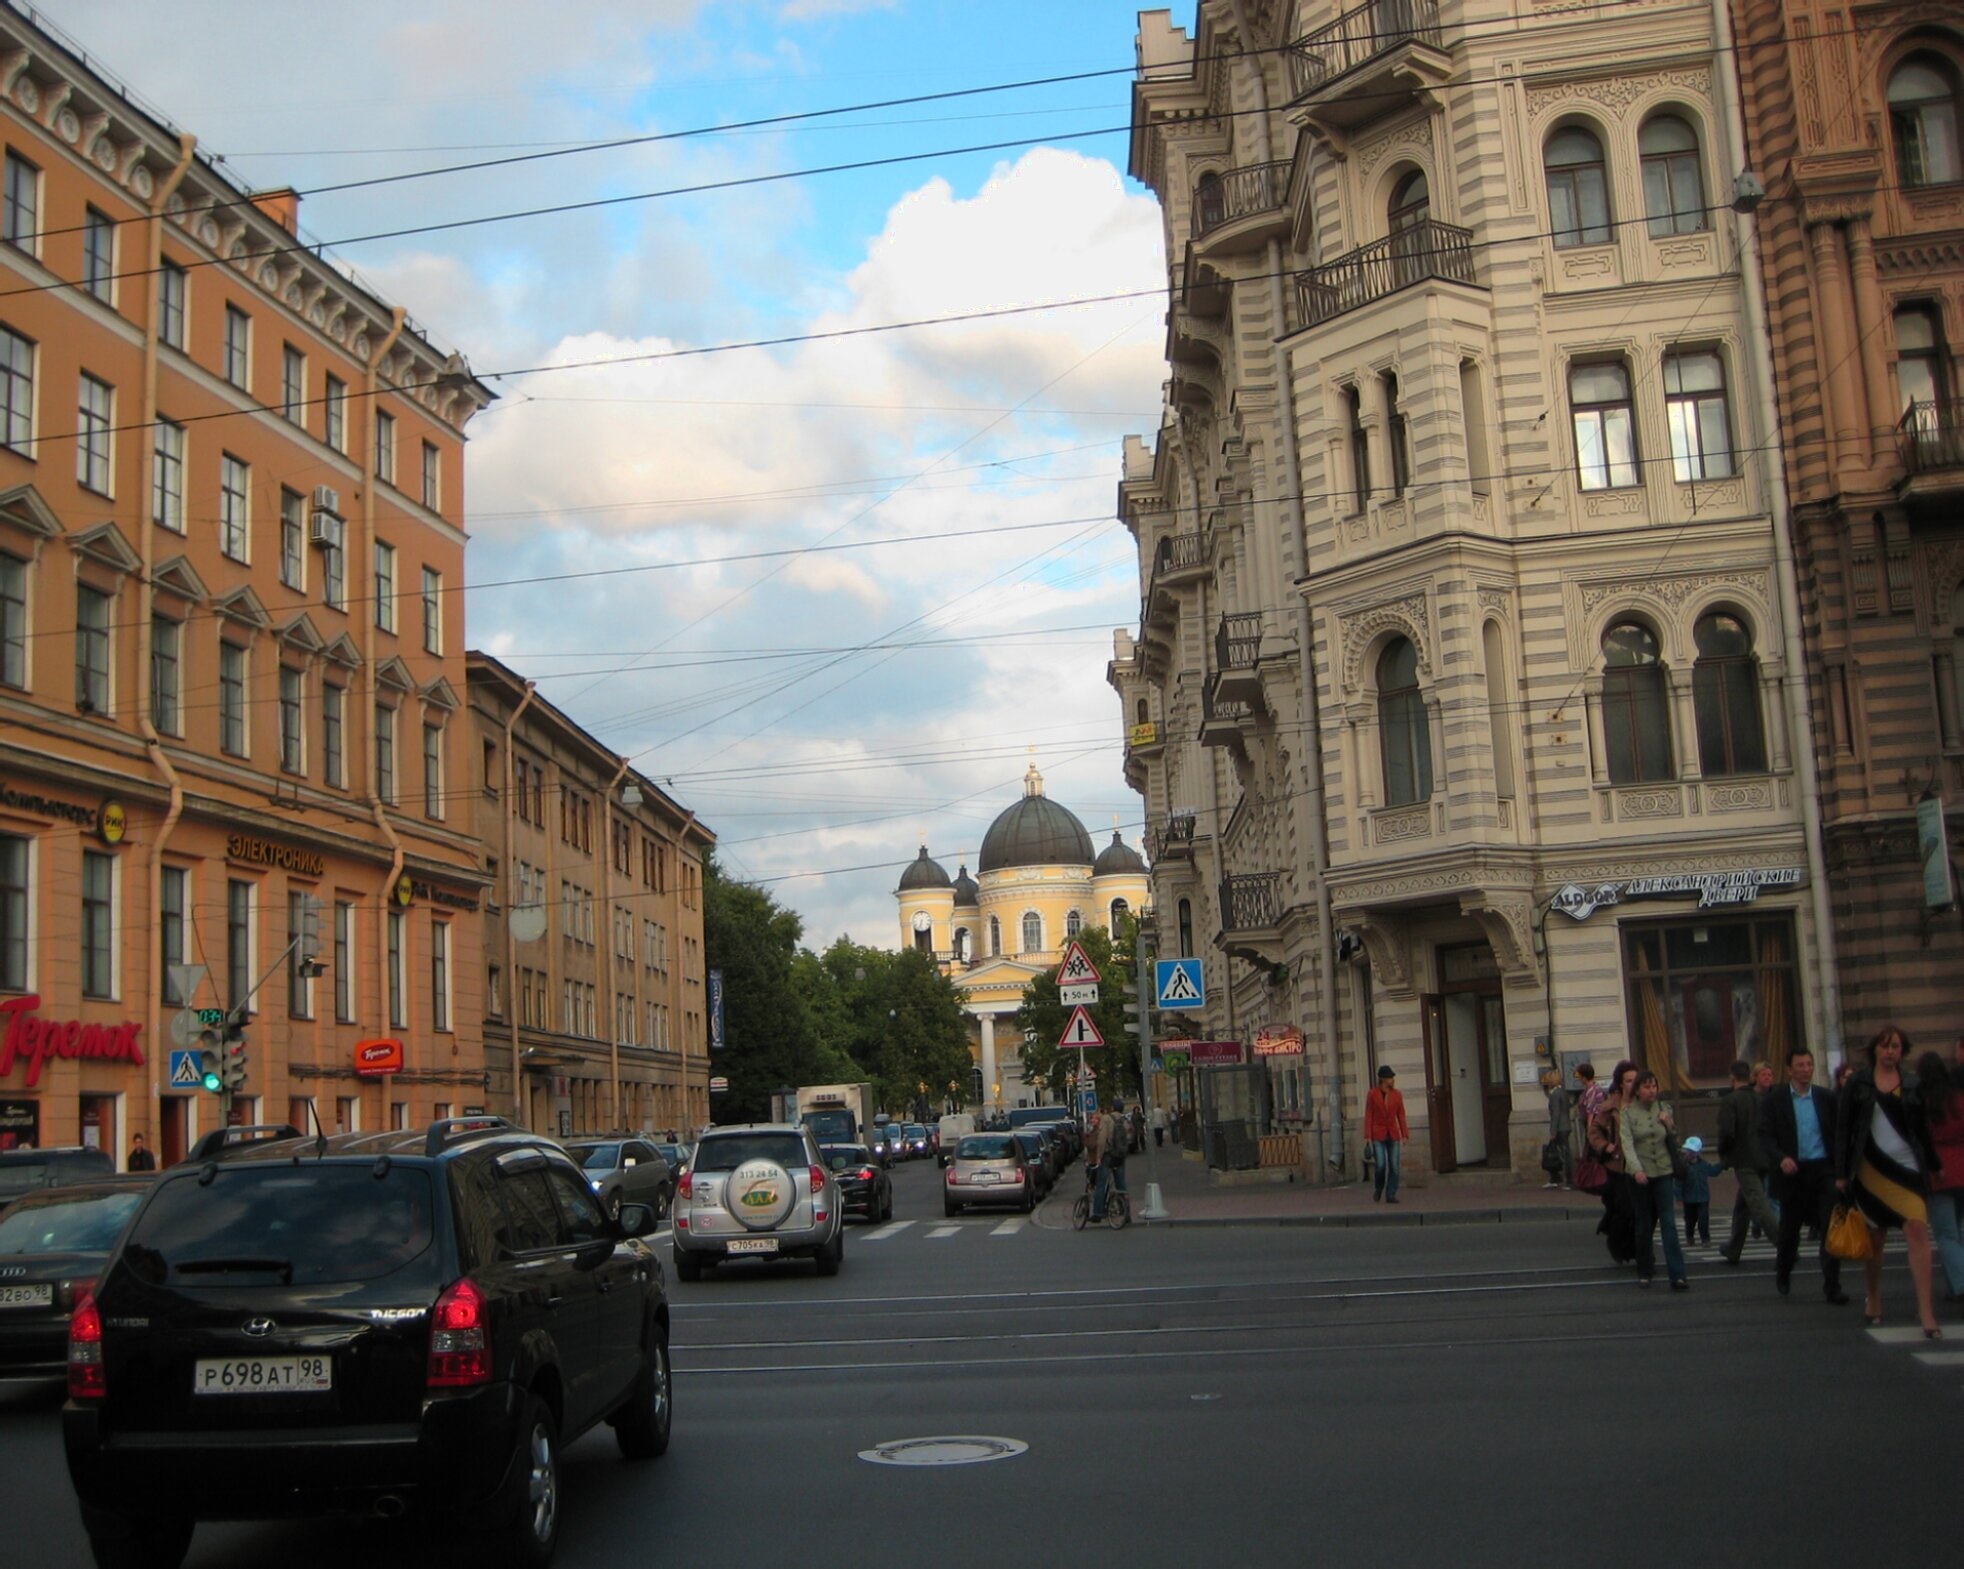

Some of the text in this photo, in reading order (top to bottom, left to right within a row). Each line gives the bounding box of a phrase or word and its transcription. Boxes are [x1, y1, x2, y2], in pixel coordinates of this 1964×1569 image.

[228, 834, 325, 876] ЭЛЕКТРОНИКА
[1626, 867, 1800, 895] АЛЕКСАНДРИЙСКИЕ
[1699, 885, 1759, 908] ДВЕРИ
[1071, 991, 1082, 999] 50
[0, 994, 145, 1088] Теремок
[34, 1285, 48, 1297] 98
[370, 1308, 427, 1319] TUCSON
[301, 1358, 323, 1377] 98
